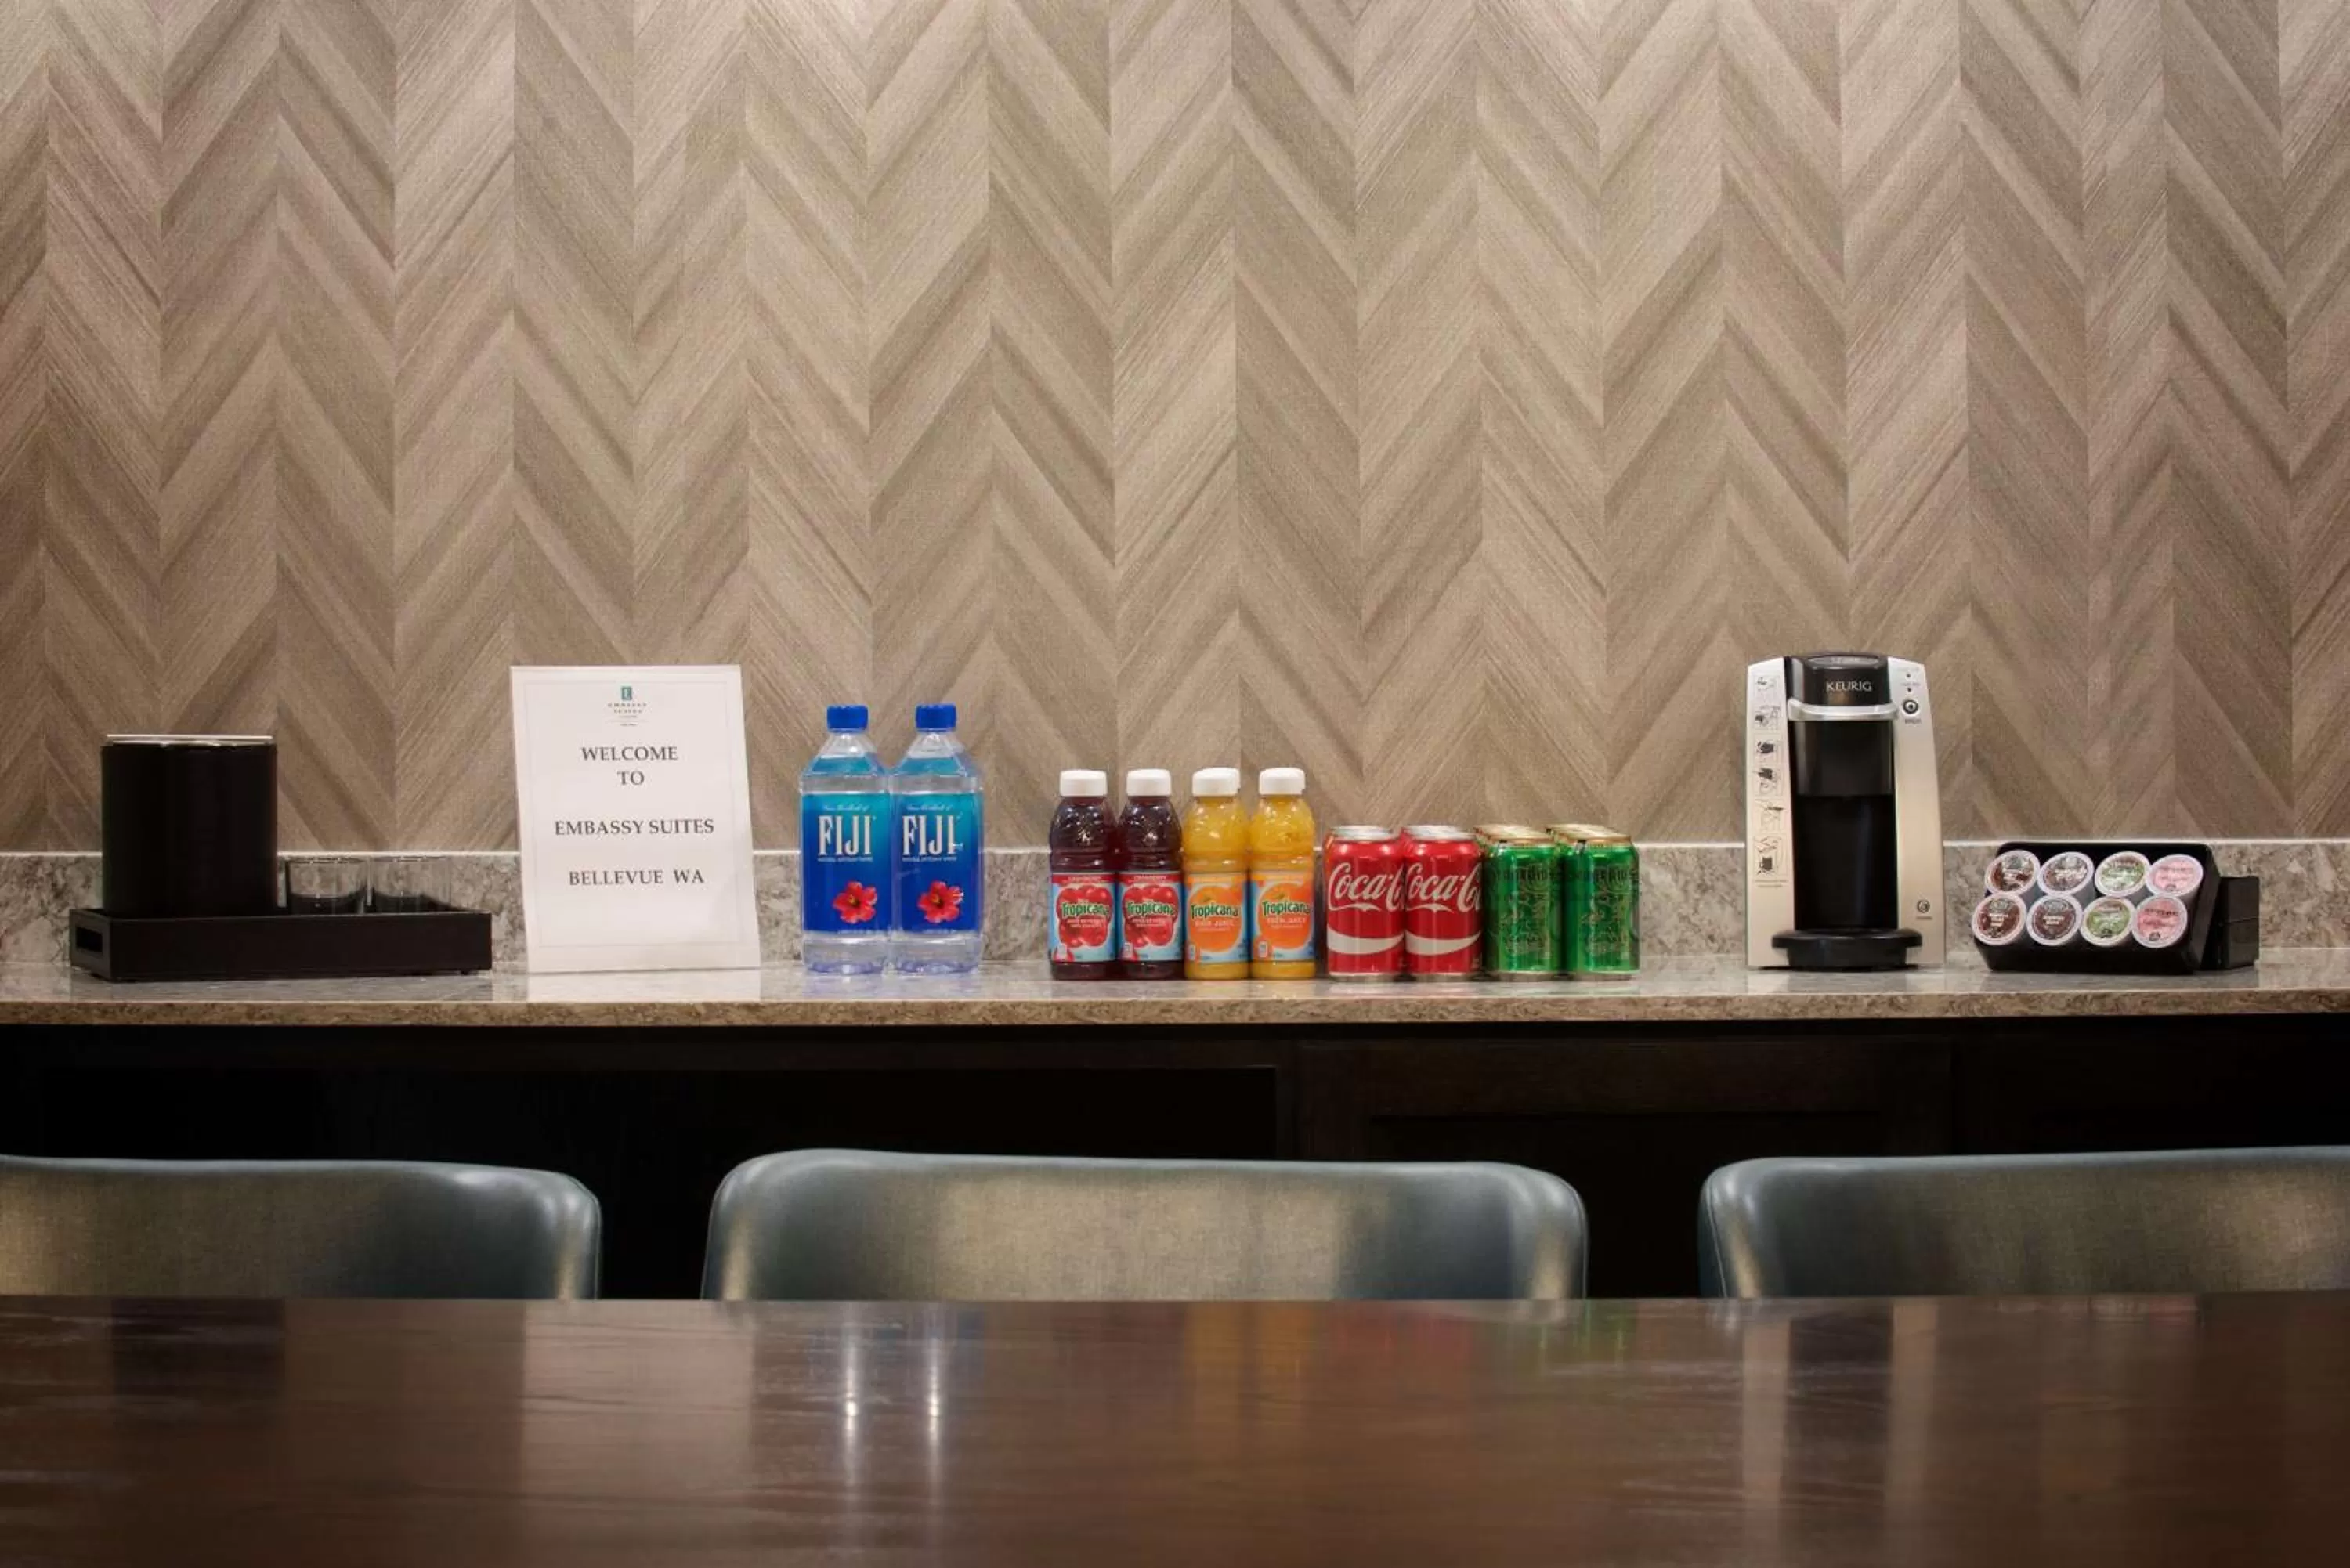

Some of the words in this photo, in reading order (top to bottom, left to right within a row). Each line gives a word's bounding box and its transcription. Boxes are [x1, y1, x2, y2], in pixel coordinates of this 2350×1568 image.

[1826, 681, 1873, 692] KEURIG
[581, 746, 678, 761] WELCOME
[617, 770, 645, 786] TO
[555, 820, 644, 836] EMBASSY
[648, 818, 714, 834] SUITES
[902, 815, 955, 855] FIJI
[818, 815, 871, 856] FIJI
[569, 869, 664, 886] BELLEVUE
[673, 869, 704, 884] WA
[1061, 901, 1110, 919] Tropicana
[1126, 901, 1174, 917] Tropicana
[1190, 904, 1238, 919] Tropicana
[1262, 900, 1311, 916] Tropicana
